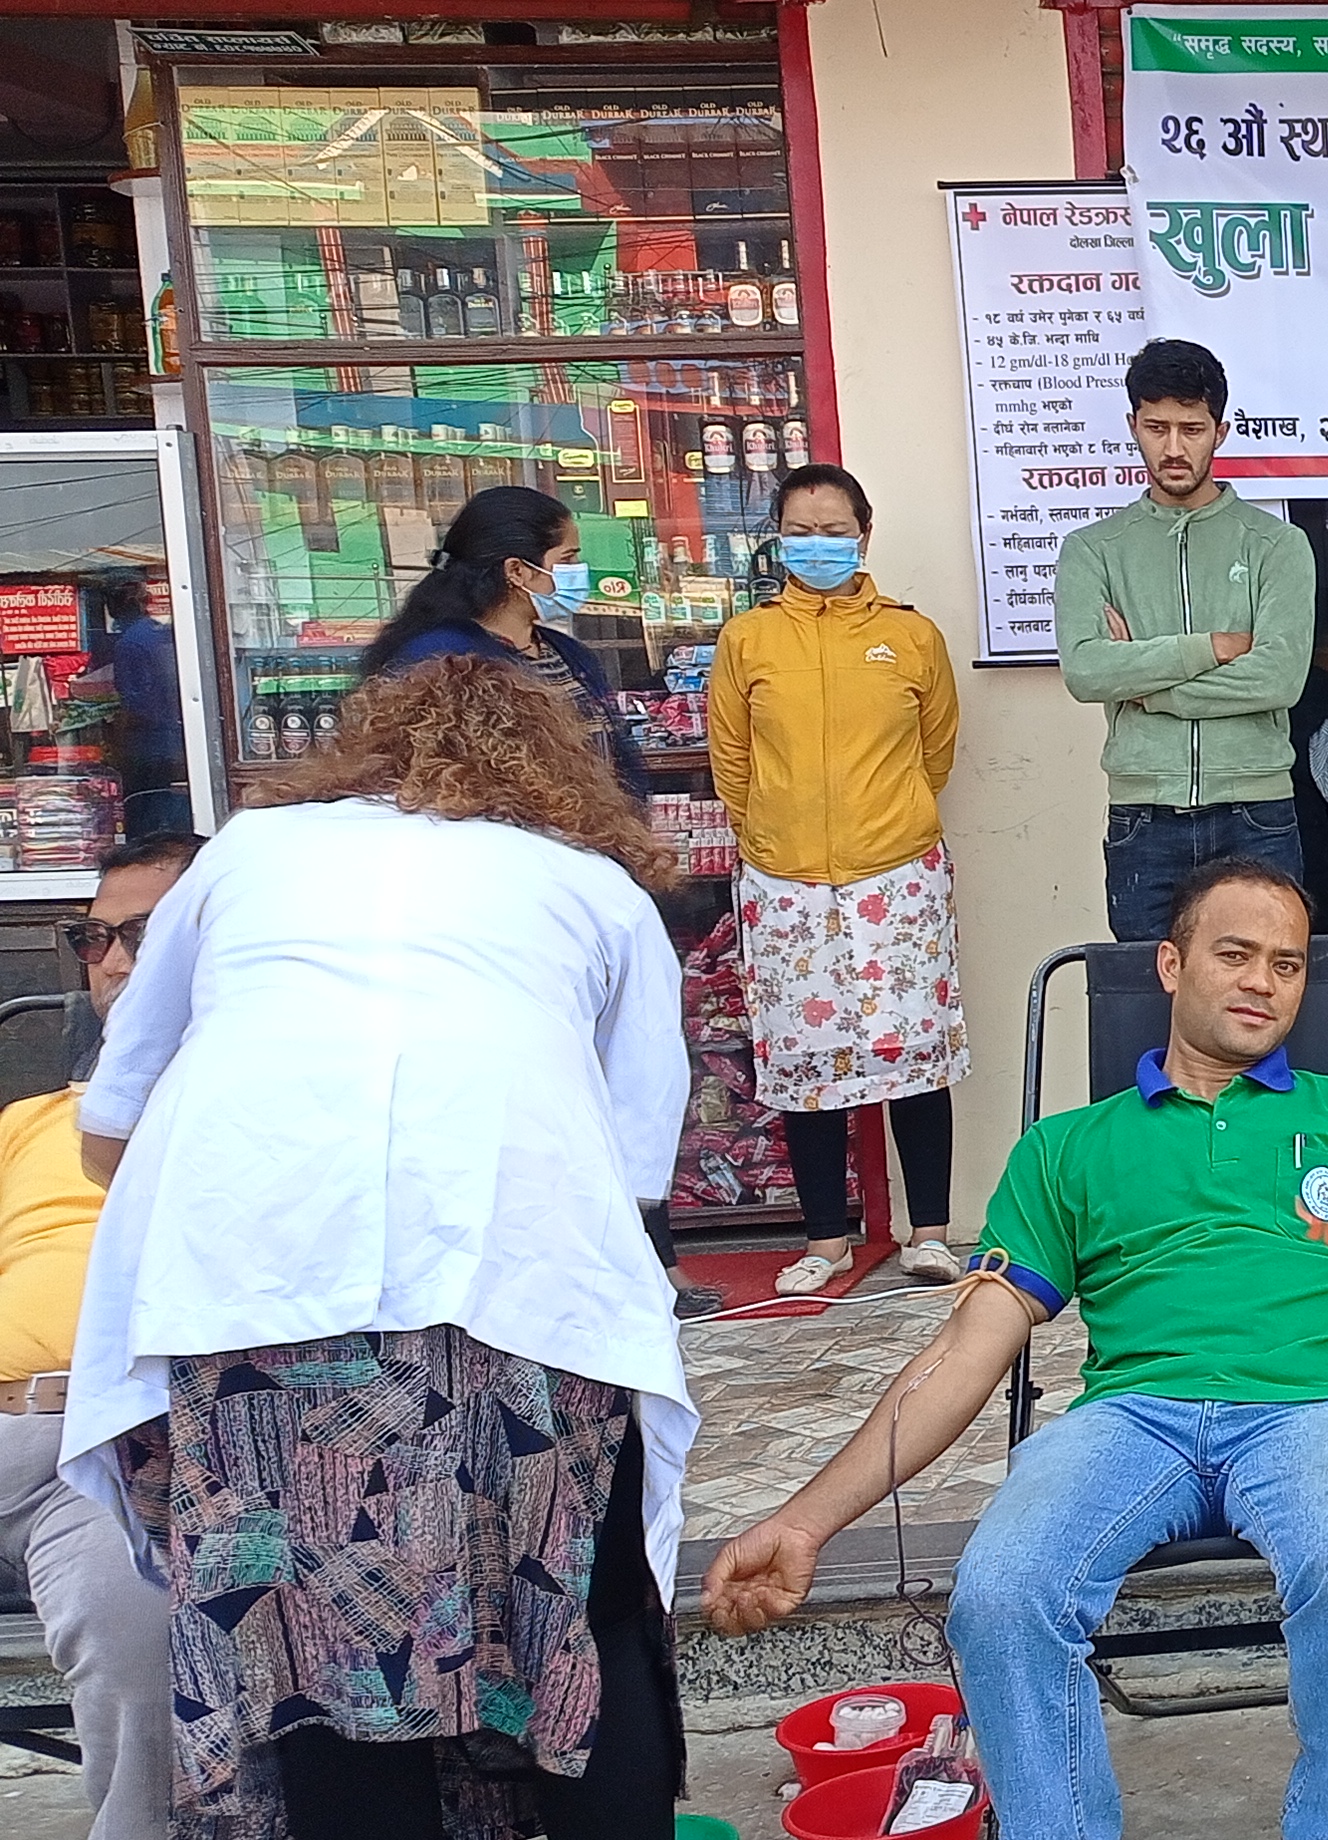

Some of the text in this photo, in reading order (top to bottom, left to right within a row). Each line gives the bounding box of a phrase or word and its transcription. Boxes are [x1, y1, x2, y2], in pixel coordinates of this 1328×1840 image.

[1161, 114, 1205, 160] २६
[1000, 202, 1059, 227] नेपाल
[1146, 200, 1312, 294] खुला
[1010, 272, 1103, 295] रक्तदान
[990, 356, 1006, 369] 12
[1073, 353, 1110, 370] gm/dl
[1021, 466, 1107, 490] रक्तदान
